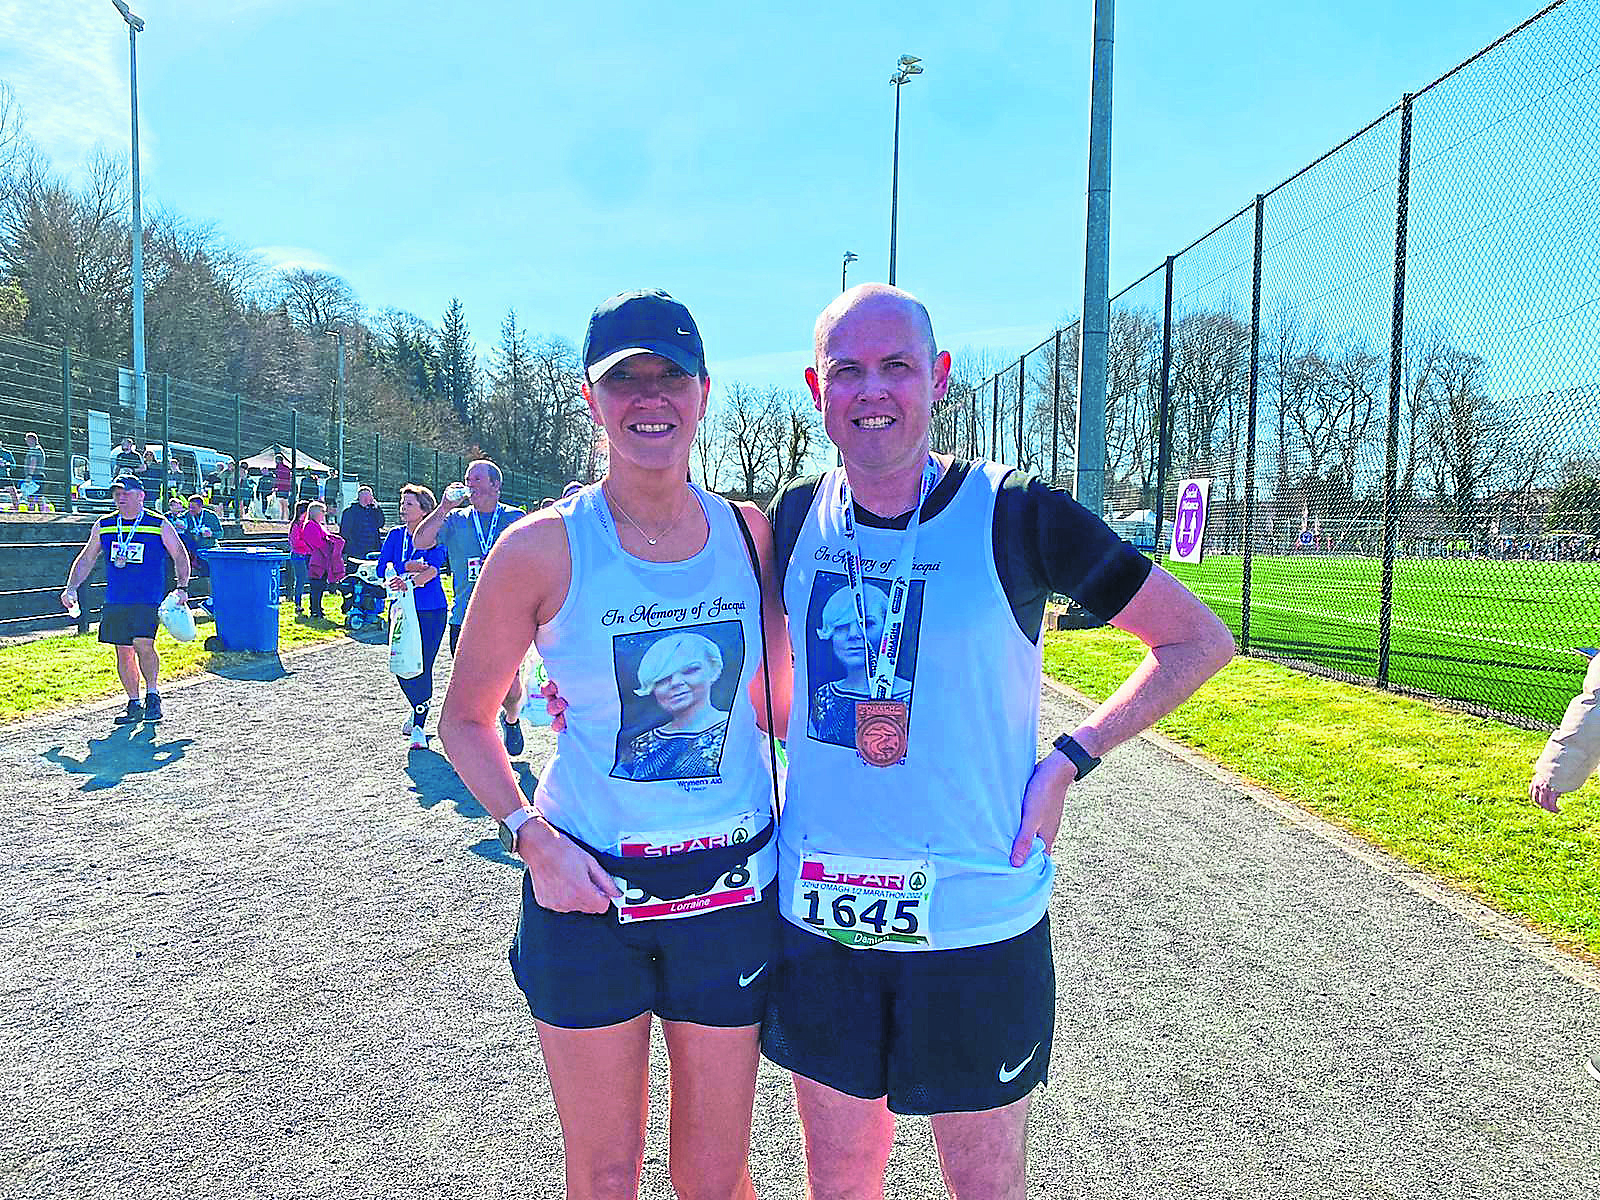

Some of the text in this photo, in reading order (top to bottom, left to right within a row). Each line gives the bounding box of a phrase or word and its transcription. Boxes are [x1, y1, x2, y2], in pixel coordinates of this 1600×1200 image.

[815, 546, 830, 561] In
[880, 559, 896, 573] of
[601, 597, 746, 627] In Memory of Jacqui
[644, 834, 727, 858] SPAR
[821, 884, 850, 893] OMAGH
[852, 887, 863, 895] 1/2
[863, 889, 905, 899] MARATHON
[670, 898, 711, 912] Lorraine
[802, 890, 920, 934] 1645
